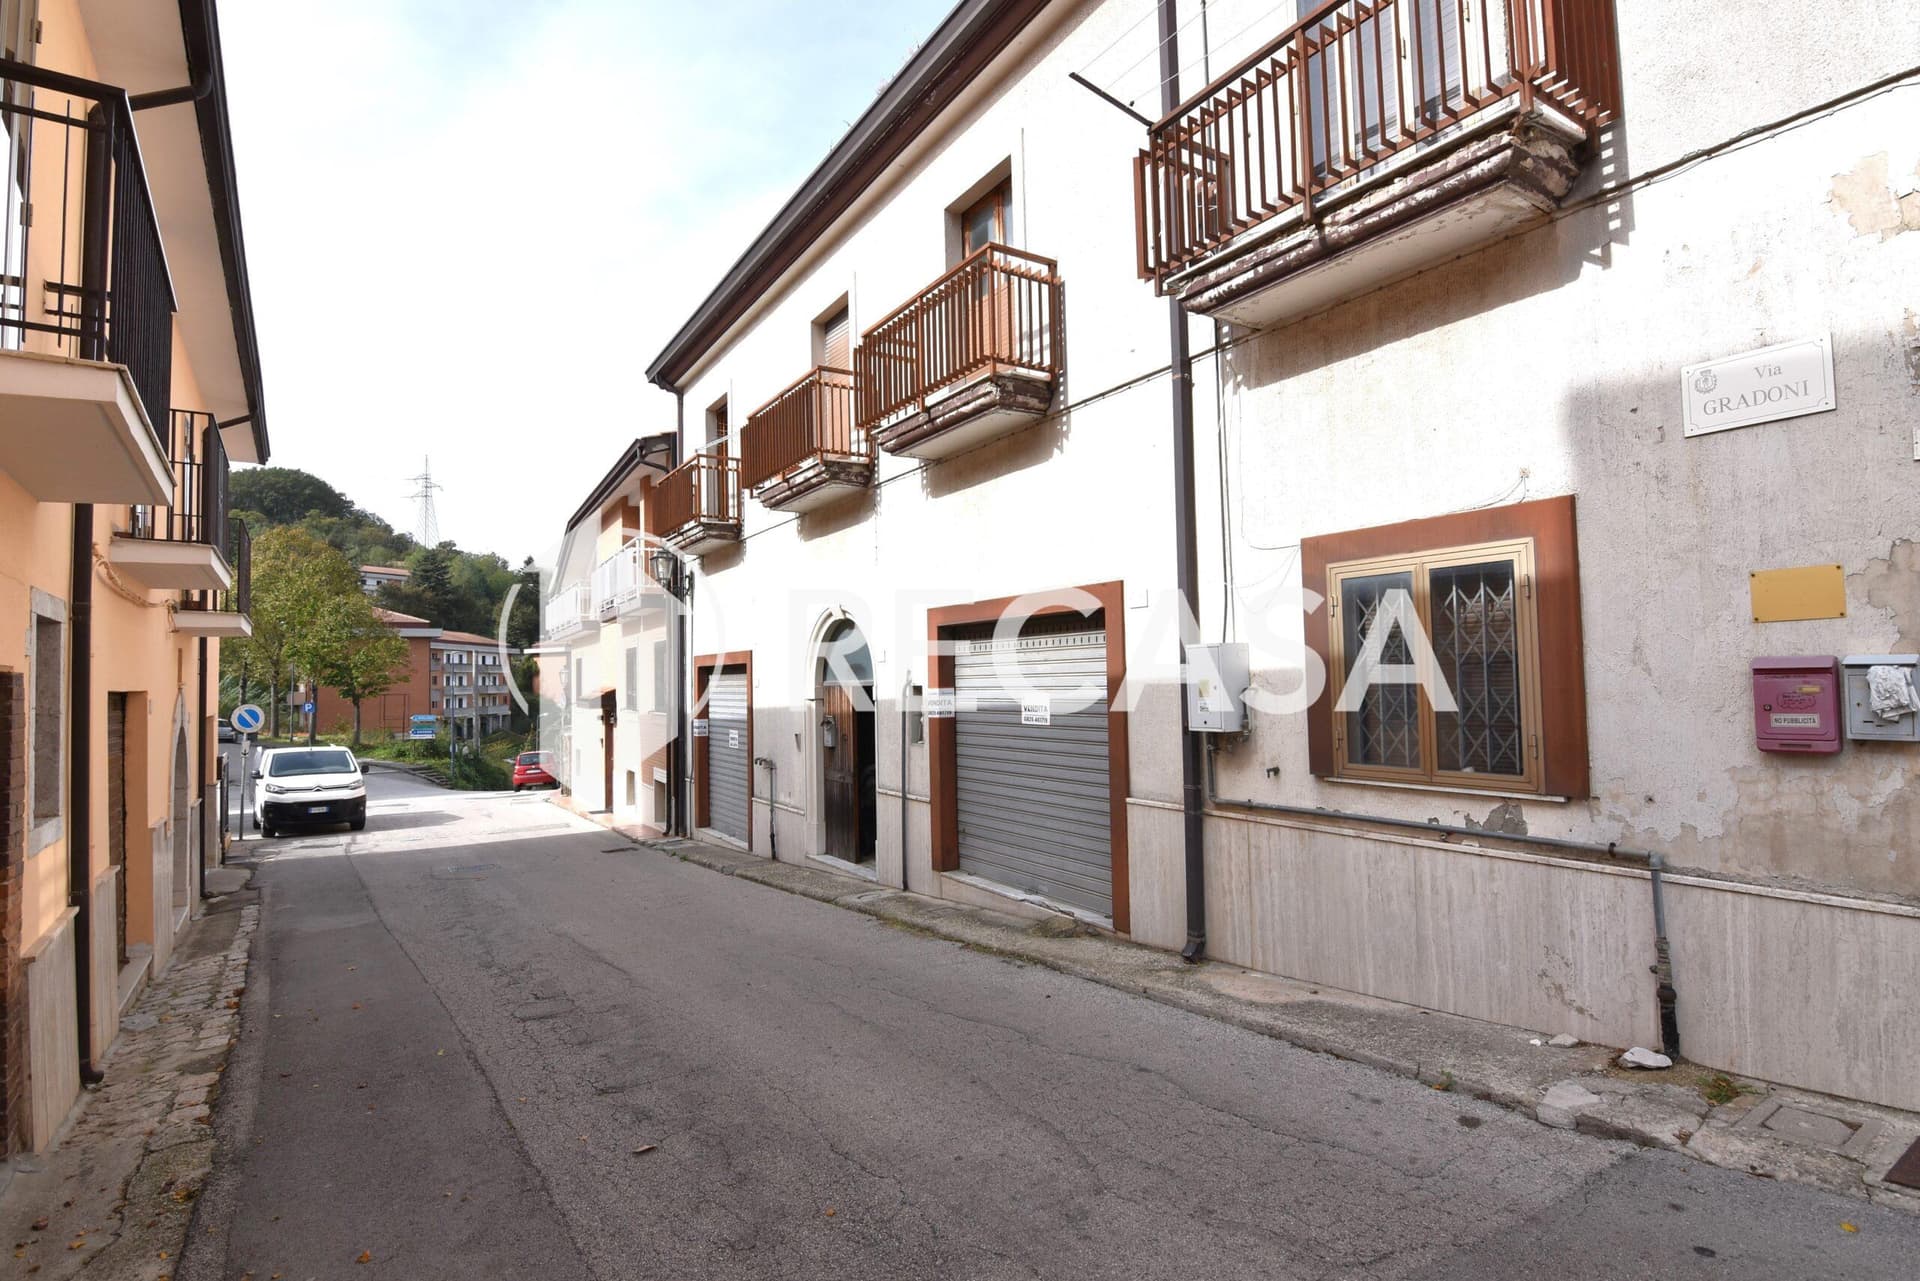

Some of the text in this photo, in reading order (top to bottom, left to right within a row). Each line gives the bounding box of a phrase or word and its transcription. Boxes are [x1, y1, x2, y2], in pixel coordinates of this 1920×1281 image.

[1754, 364, 1782, 379] Via
[1703, 380, 1809, 416] GRADONI
[305, 703, 313, 712] P
